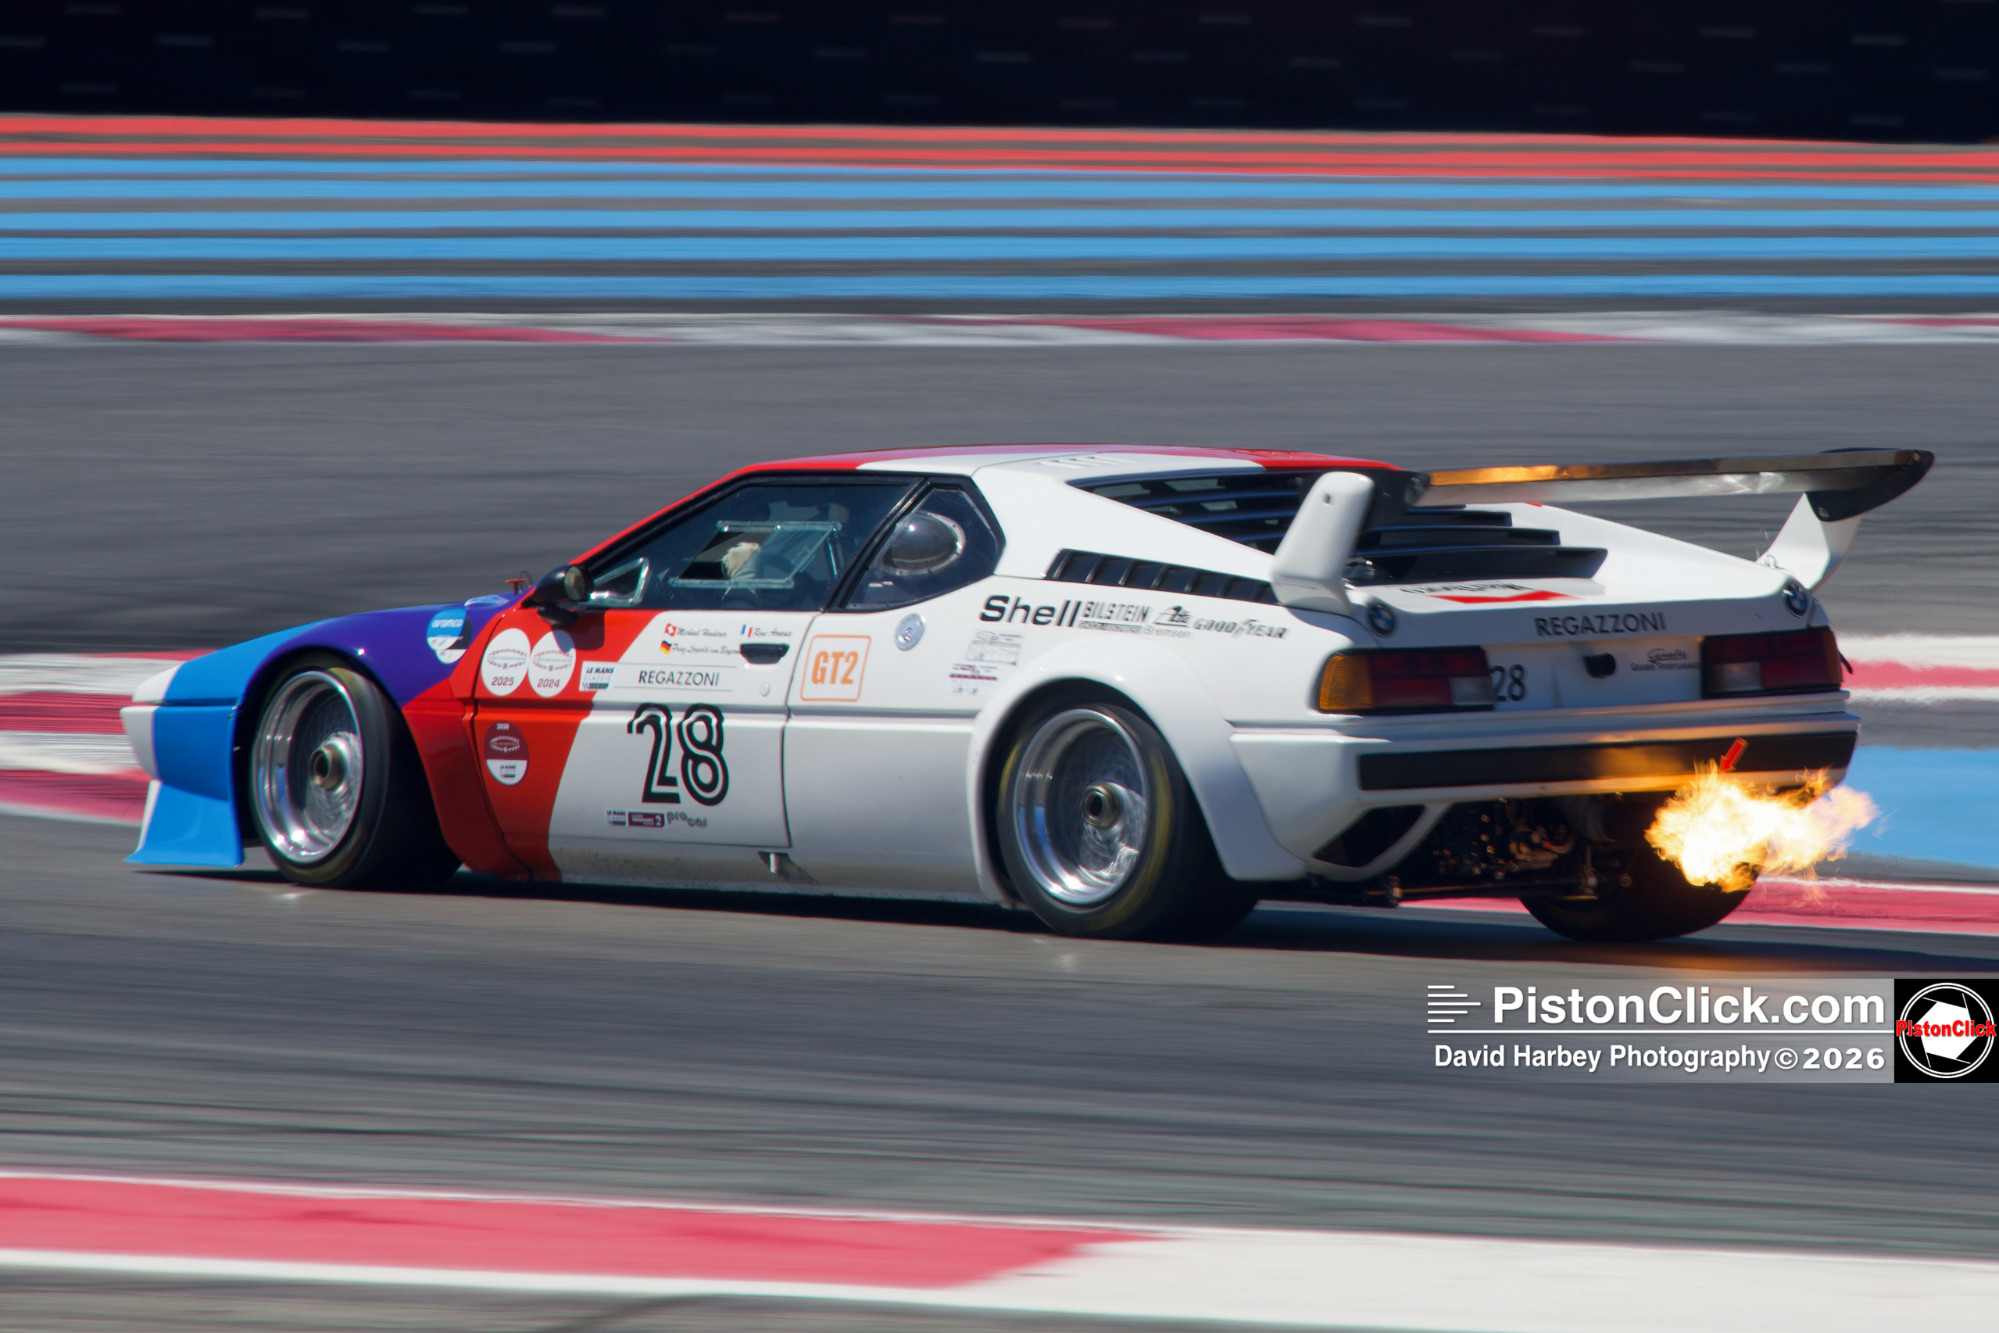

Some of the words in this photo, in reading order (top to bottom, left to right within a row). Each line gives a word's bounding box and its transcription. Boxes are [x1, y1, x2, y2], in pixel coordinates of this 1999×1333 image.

[978, 595, 1082, 627] Shell
[1082, 600, 1151, 623] BILSTEIN
[1534, 611, 1667, 637] REGAZZONI
[491, 676, 514, 686] 2025
[638, 670, 720, 687] REGAZZONI
[811, 651, 860, 685] GT2
[537, 678, 560, 688] 2024
[1489, 664, 1527, 701] 28
[626, 702, 730, 806] 28
